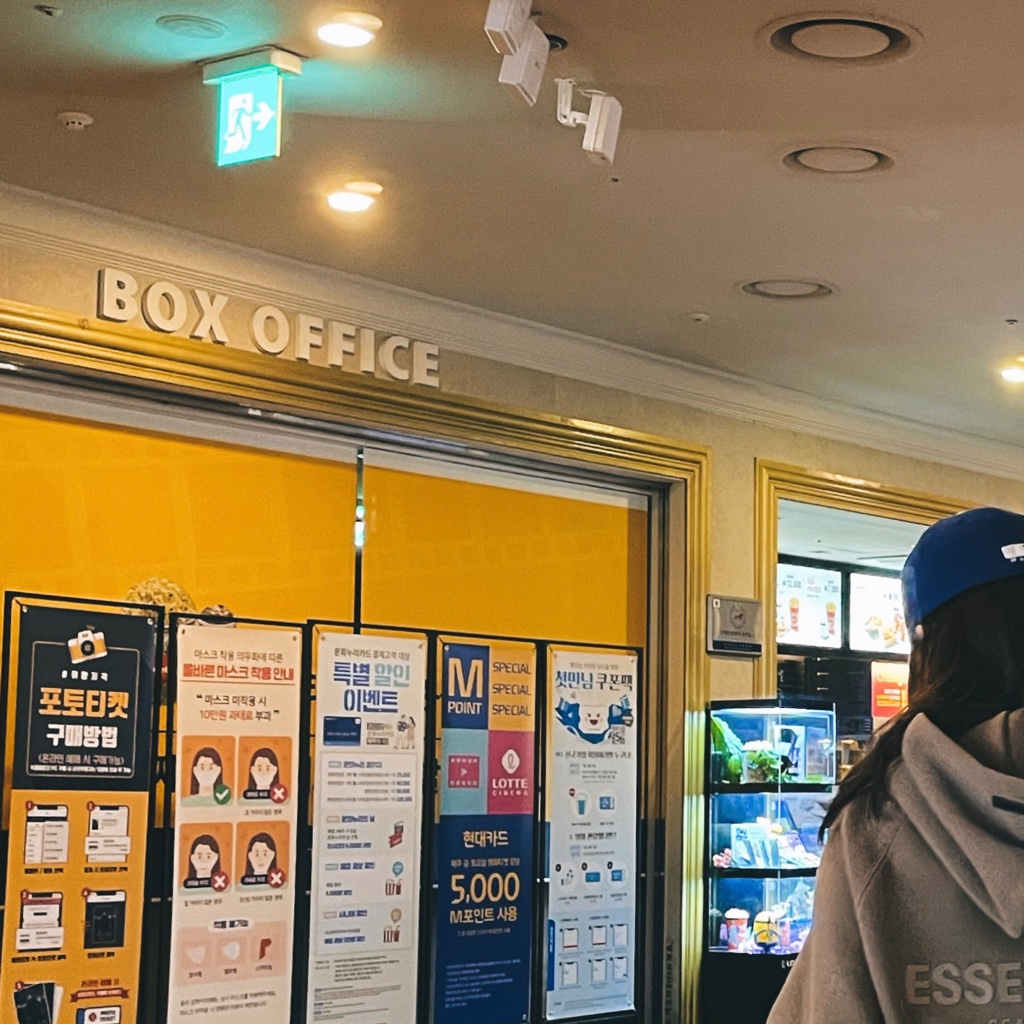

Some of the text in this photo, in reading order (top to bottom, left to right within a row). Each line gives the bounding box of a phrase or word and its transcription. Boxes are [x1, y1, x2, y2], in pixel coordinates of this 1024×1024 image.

[98, 267, 441, 389] BOX OFFICE
[194, 649, 218, 659] 마스크
[220, 650, 235, 661] 착용
[268, 653, 284, 664] 따른
[182, 663, 295, 681] 올바른 마스크 착용 안내
[333, 661, 410, 688] 특별 할인
[492, 661, 532, 675] SPECIAL
[448, 657, 484, 699] M
[555, 670, 633, 691] 첫만남 쿠폰팩
[492, 682, 532, 696] SPECIAL
[38, 686, 130, 719] 포토티켓
[204, 694, 268, 707] 마스크 미착용 시
[343, 688, 399, 713] 이벤트
[448, 700, 483, 715] POINT
[200, 709, 228, 721] 10만원
[255, 710, 272, 721] 부과
[492, 704, 532, 717] SPECIAL
[46, 723, 118, 748] 구매방법
[492, 778, 528, 790] LOTTE
[463, 830, 509, 848] 현대카드
[450, 871, 521, 905] 5,000
[449, 905, 518, 924] M포인트 사용
